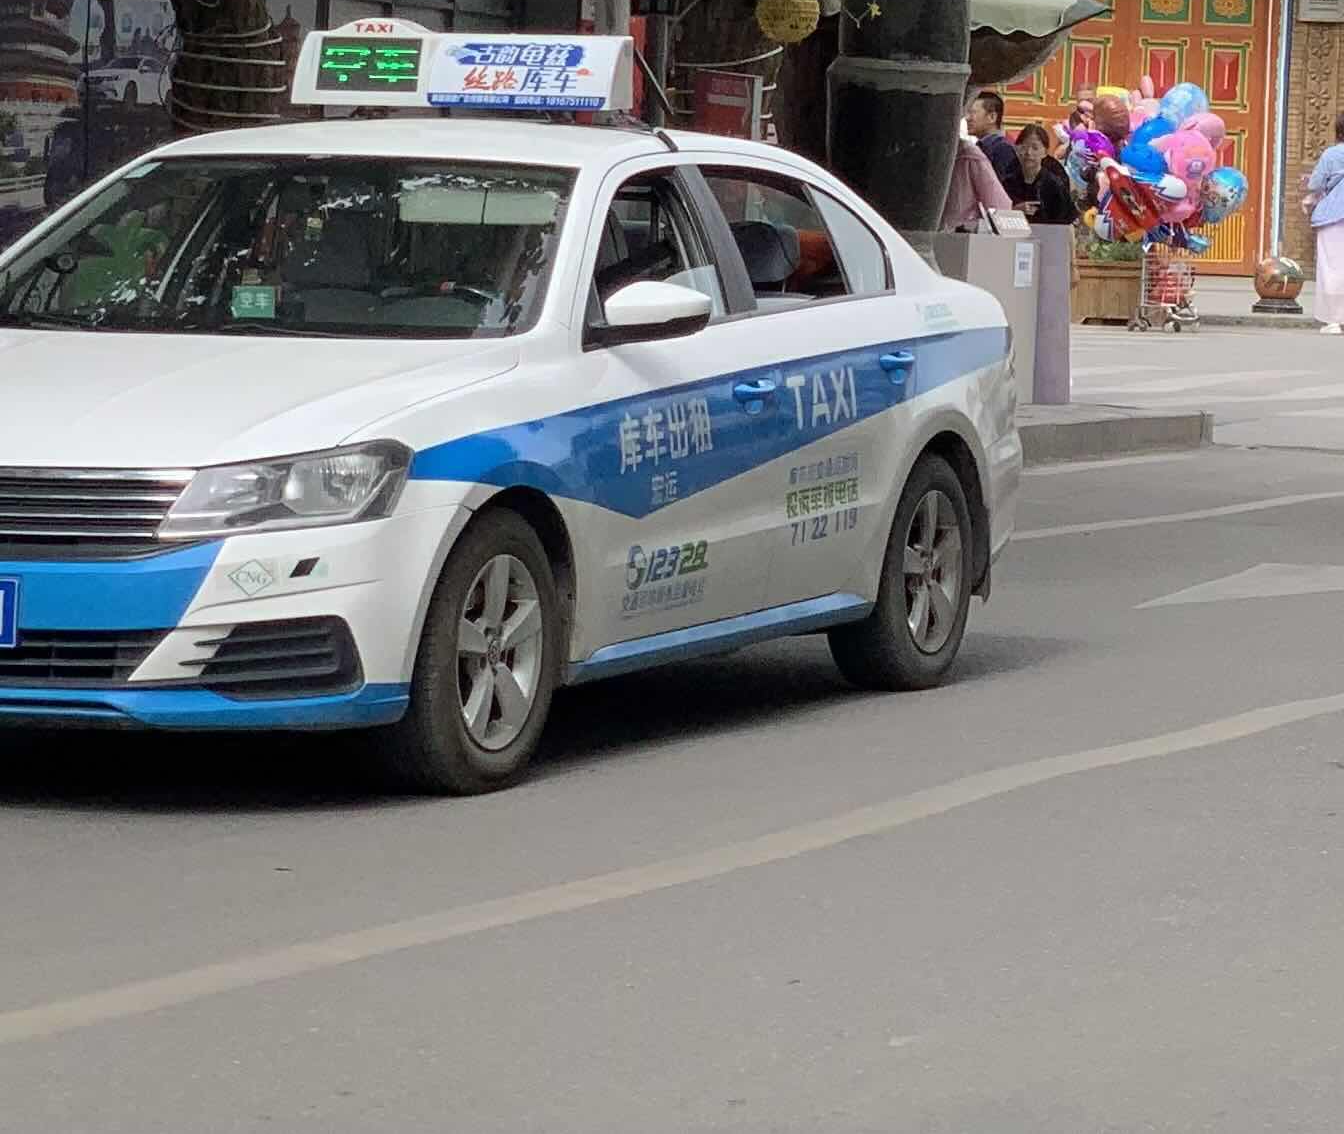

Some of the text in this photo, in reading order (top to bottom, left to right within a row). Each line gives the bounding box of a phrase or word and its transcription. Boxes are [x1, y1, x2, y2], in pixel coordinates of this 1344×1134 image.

[354, 23, 394, 34] TAXI
[463, 66, 577, 93] 丝路库车
[786, 366, 858, 430] TAXI
[620, 398, 713, 474] 库车出租
